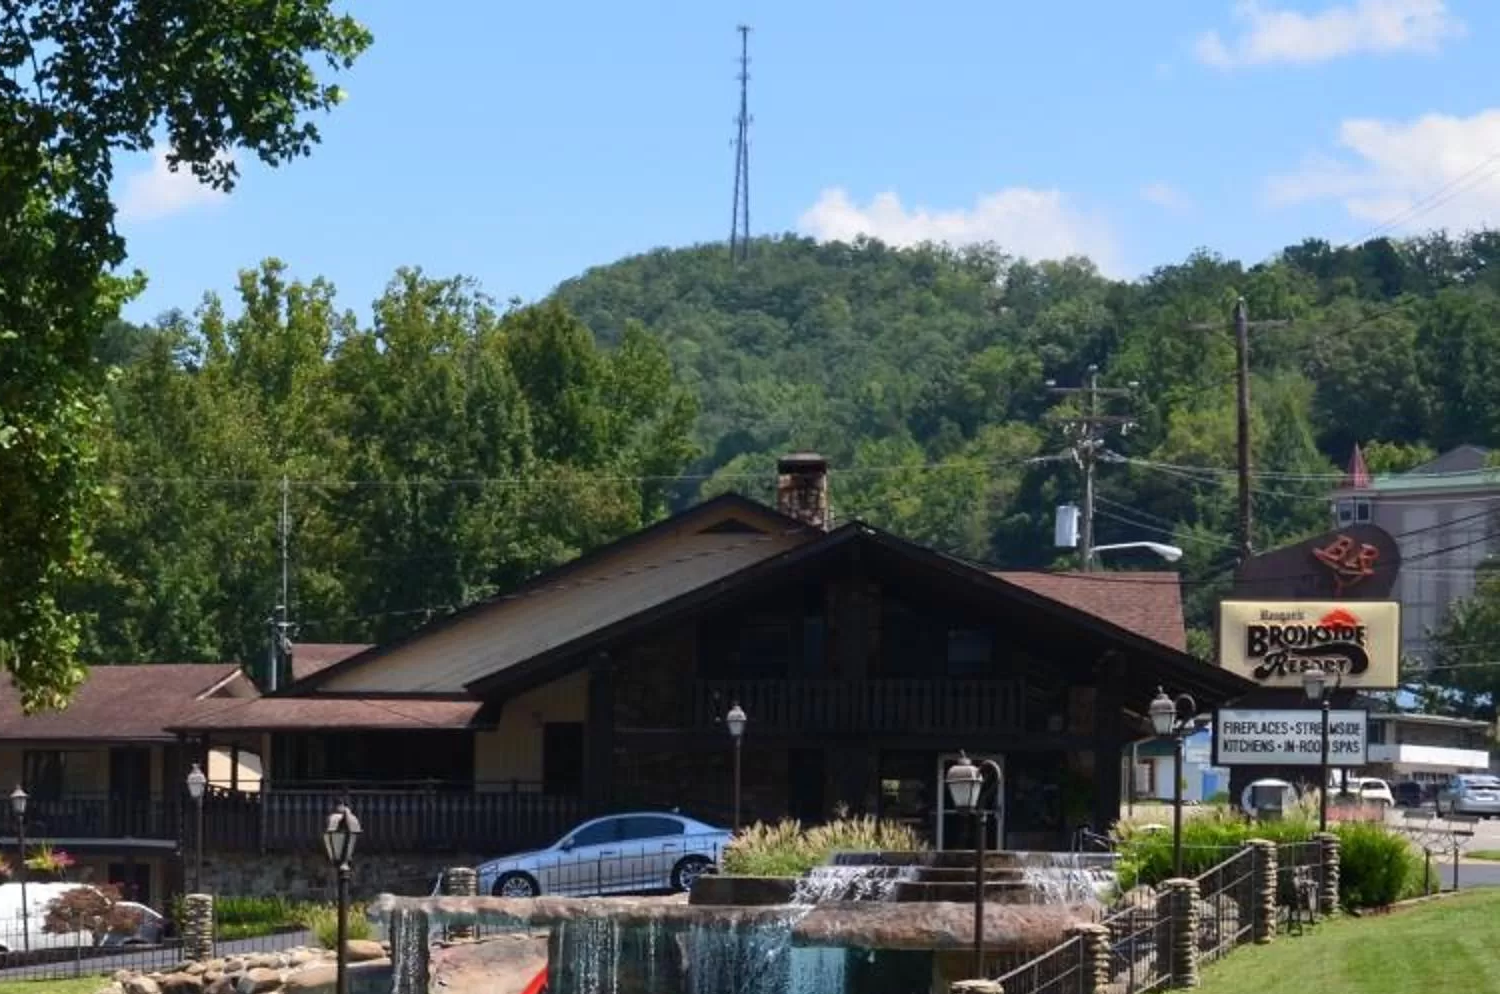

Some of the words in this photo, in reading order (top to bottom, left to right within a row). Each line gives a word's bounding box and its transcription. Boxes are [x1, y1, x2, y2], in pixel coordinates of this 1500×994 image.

[1247, 625, 1366, 656] BROOKSIDE
[1254, 652, 1347, 679] RESORT
[1223, 721, 1288, 735] FIREPLACES
[1295, 721, 1361, 735] STREMSIDE
[1223, 739, 1276, 753] KITCHENS
[1283, 739, 1330, 753] IN-ROO
[1331, 739, 1360, 753] SPAS
